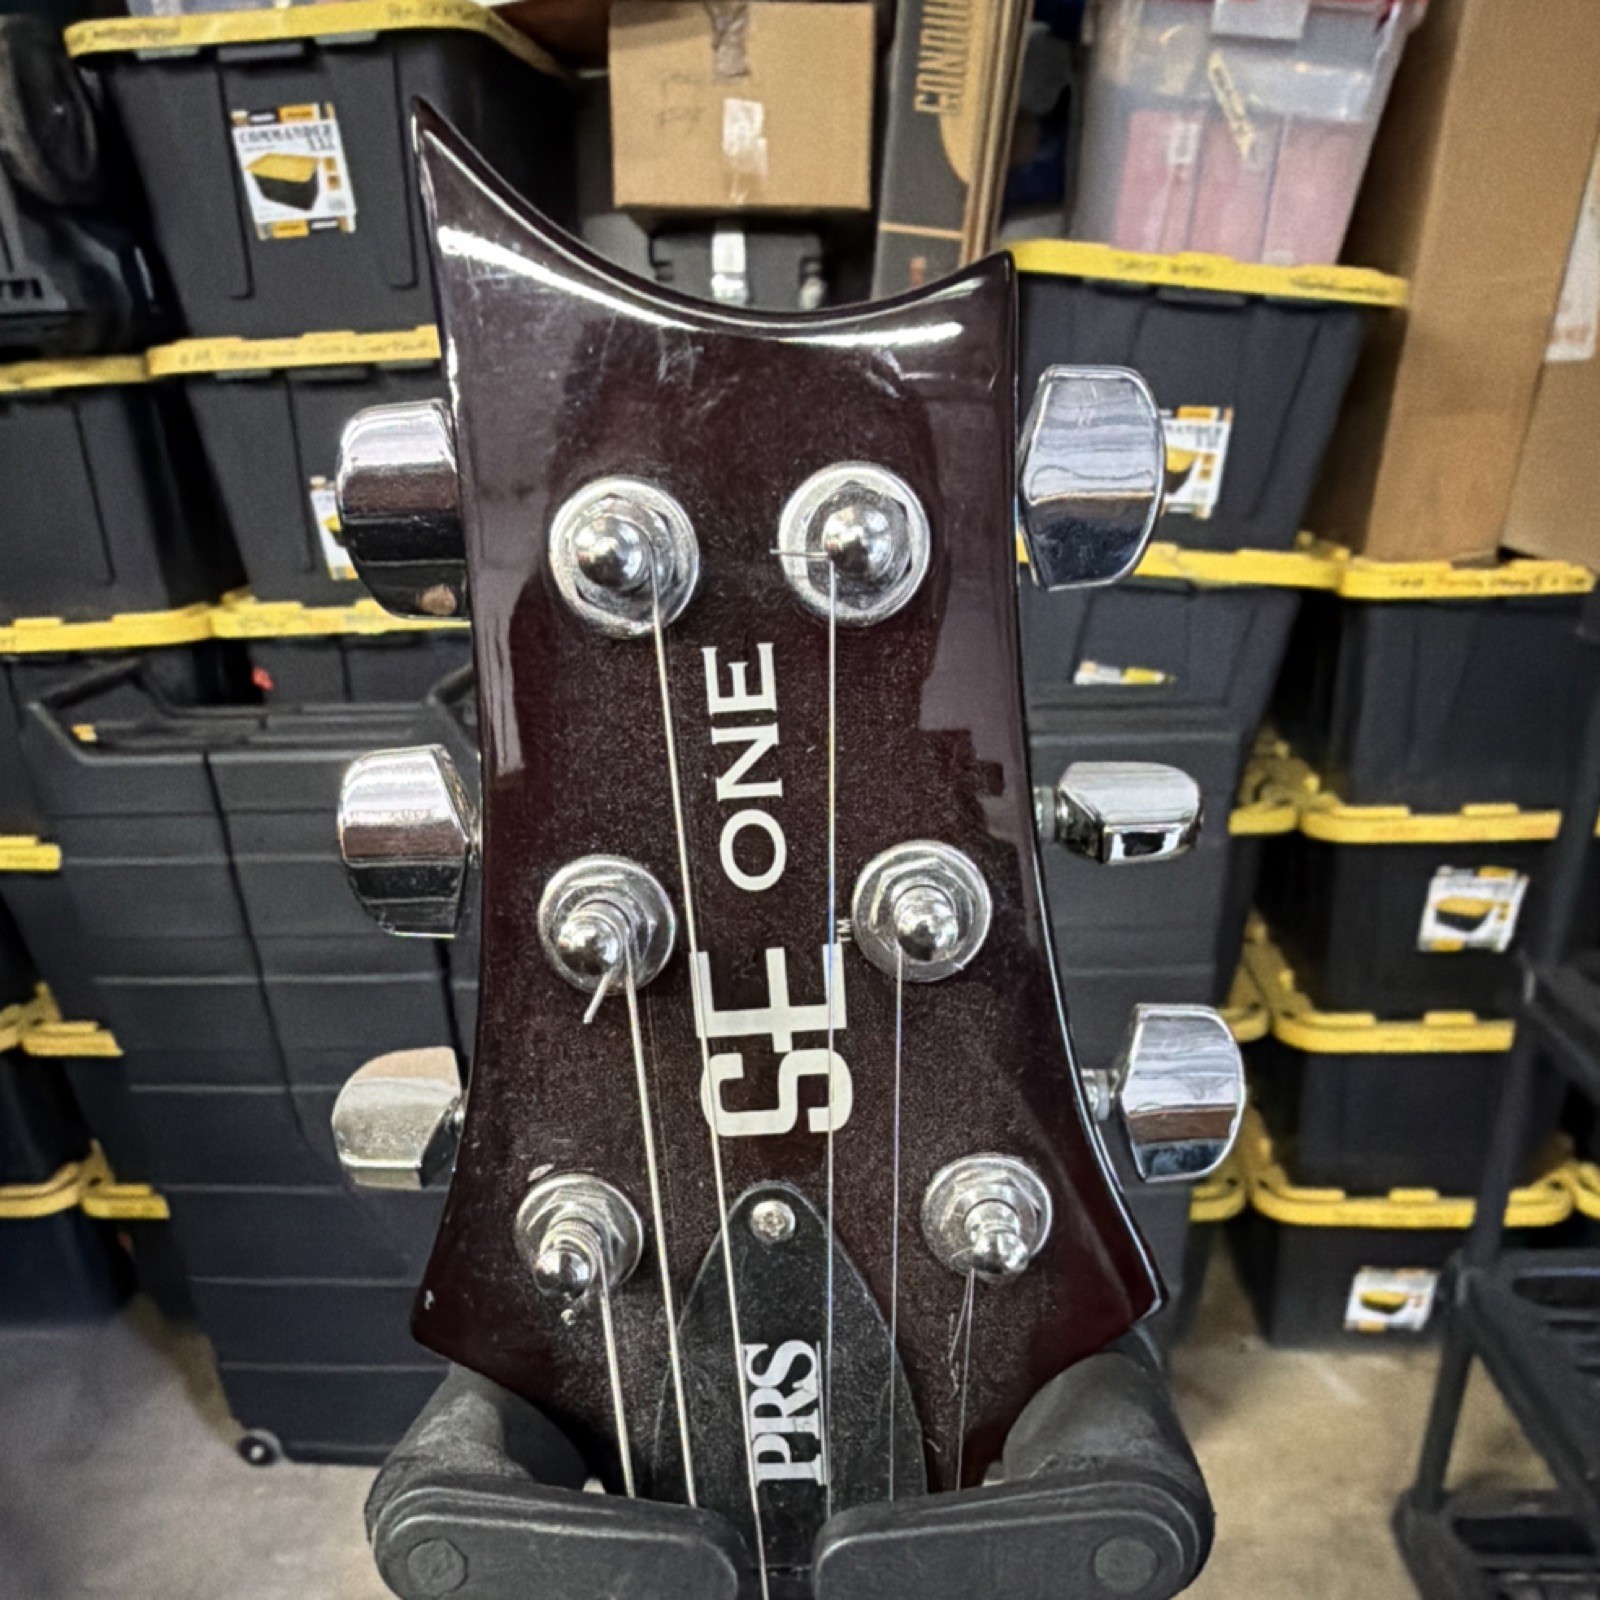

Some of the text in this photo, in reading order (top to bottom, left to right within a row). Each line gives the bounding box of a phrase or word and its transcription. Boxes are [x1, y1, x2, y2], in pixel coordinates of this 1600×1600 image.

[689, 643, 853, 1137] SE ONE
[836, 918, 852, 942] TM
[741, 1338, 825, 1487] PRS
